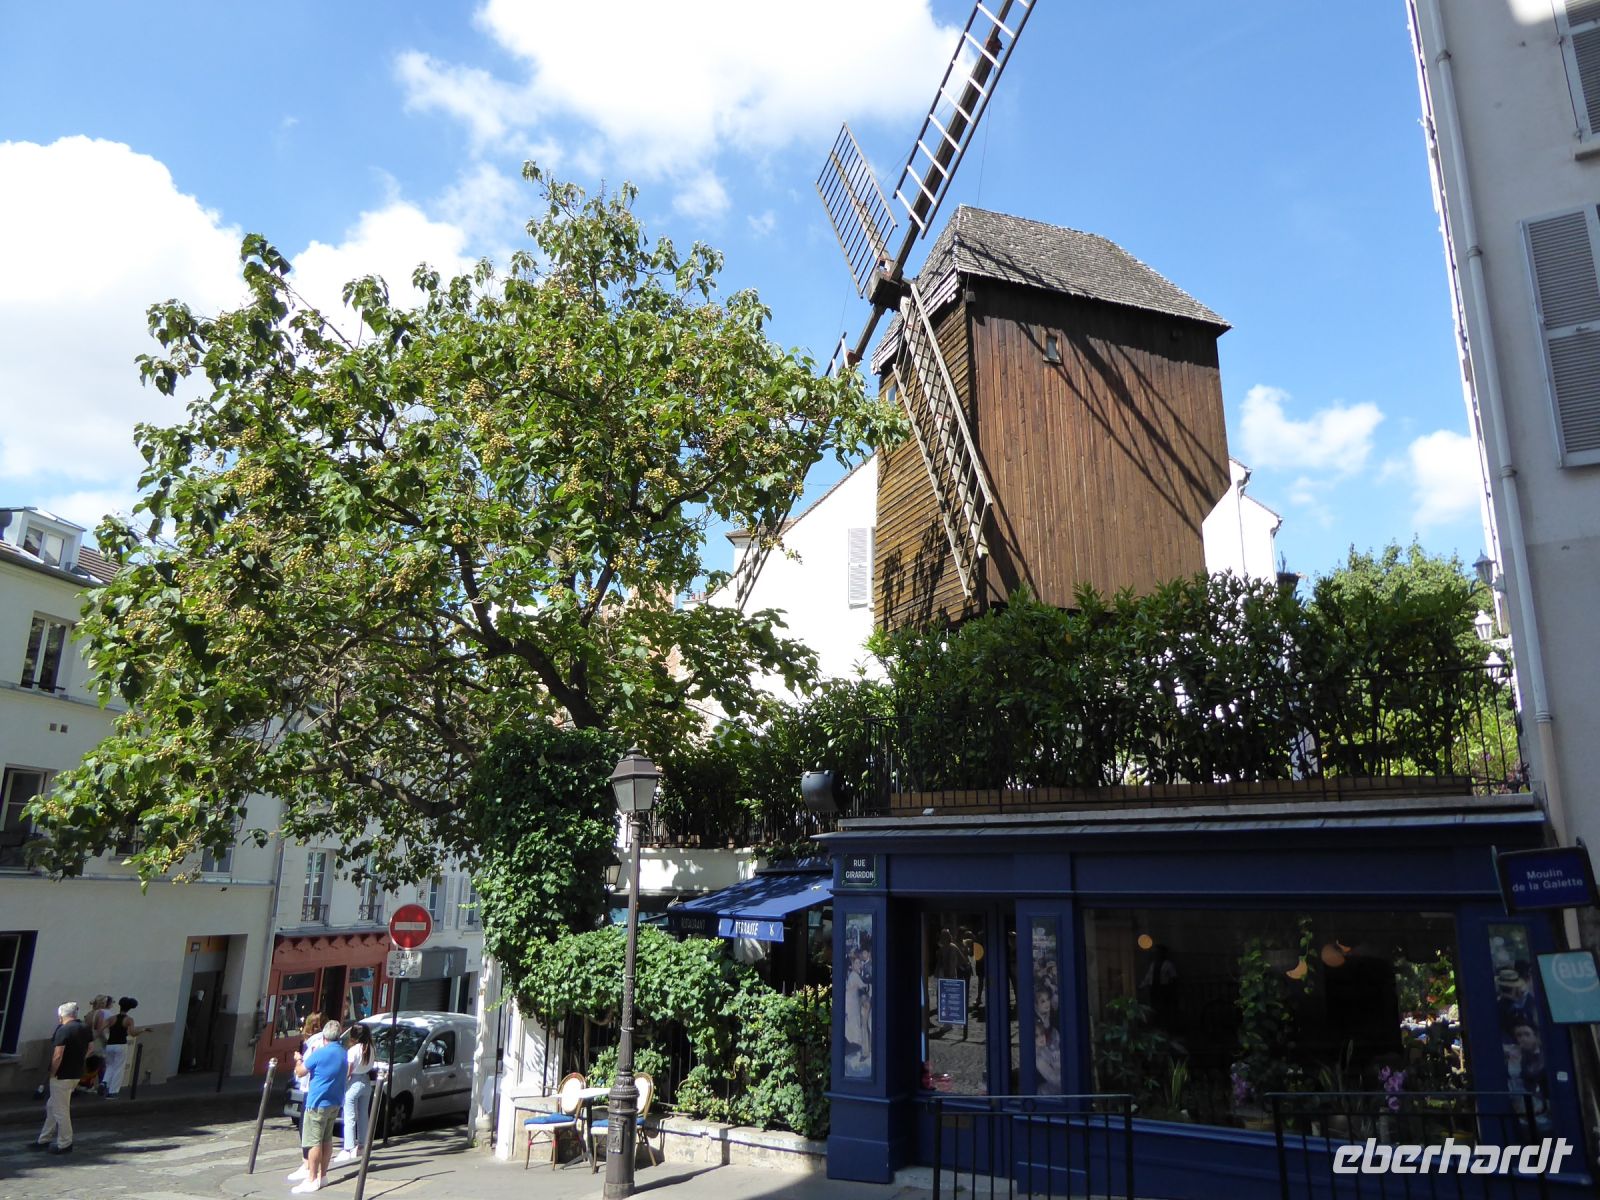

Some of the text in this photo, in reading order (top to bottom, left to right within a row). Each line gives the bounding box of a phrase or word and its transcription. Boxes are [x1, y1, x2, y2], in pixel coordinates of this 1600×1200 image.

[853, 859, 866, 867] RUE
[845, 871, 874, 879] GIRARDON
[1526, 869, 1564, 880] Moulin
[1512, 878, 1584, 893] de la Galette
[396, 952, 415, 960] SAUF
[1558, 959, 1595, 979] BUS
